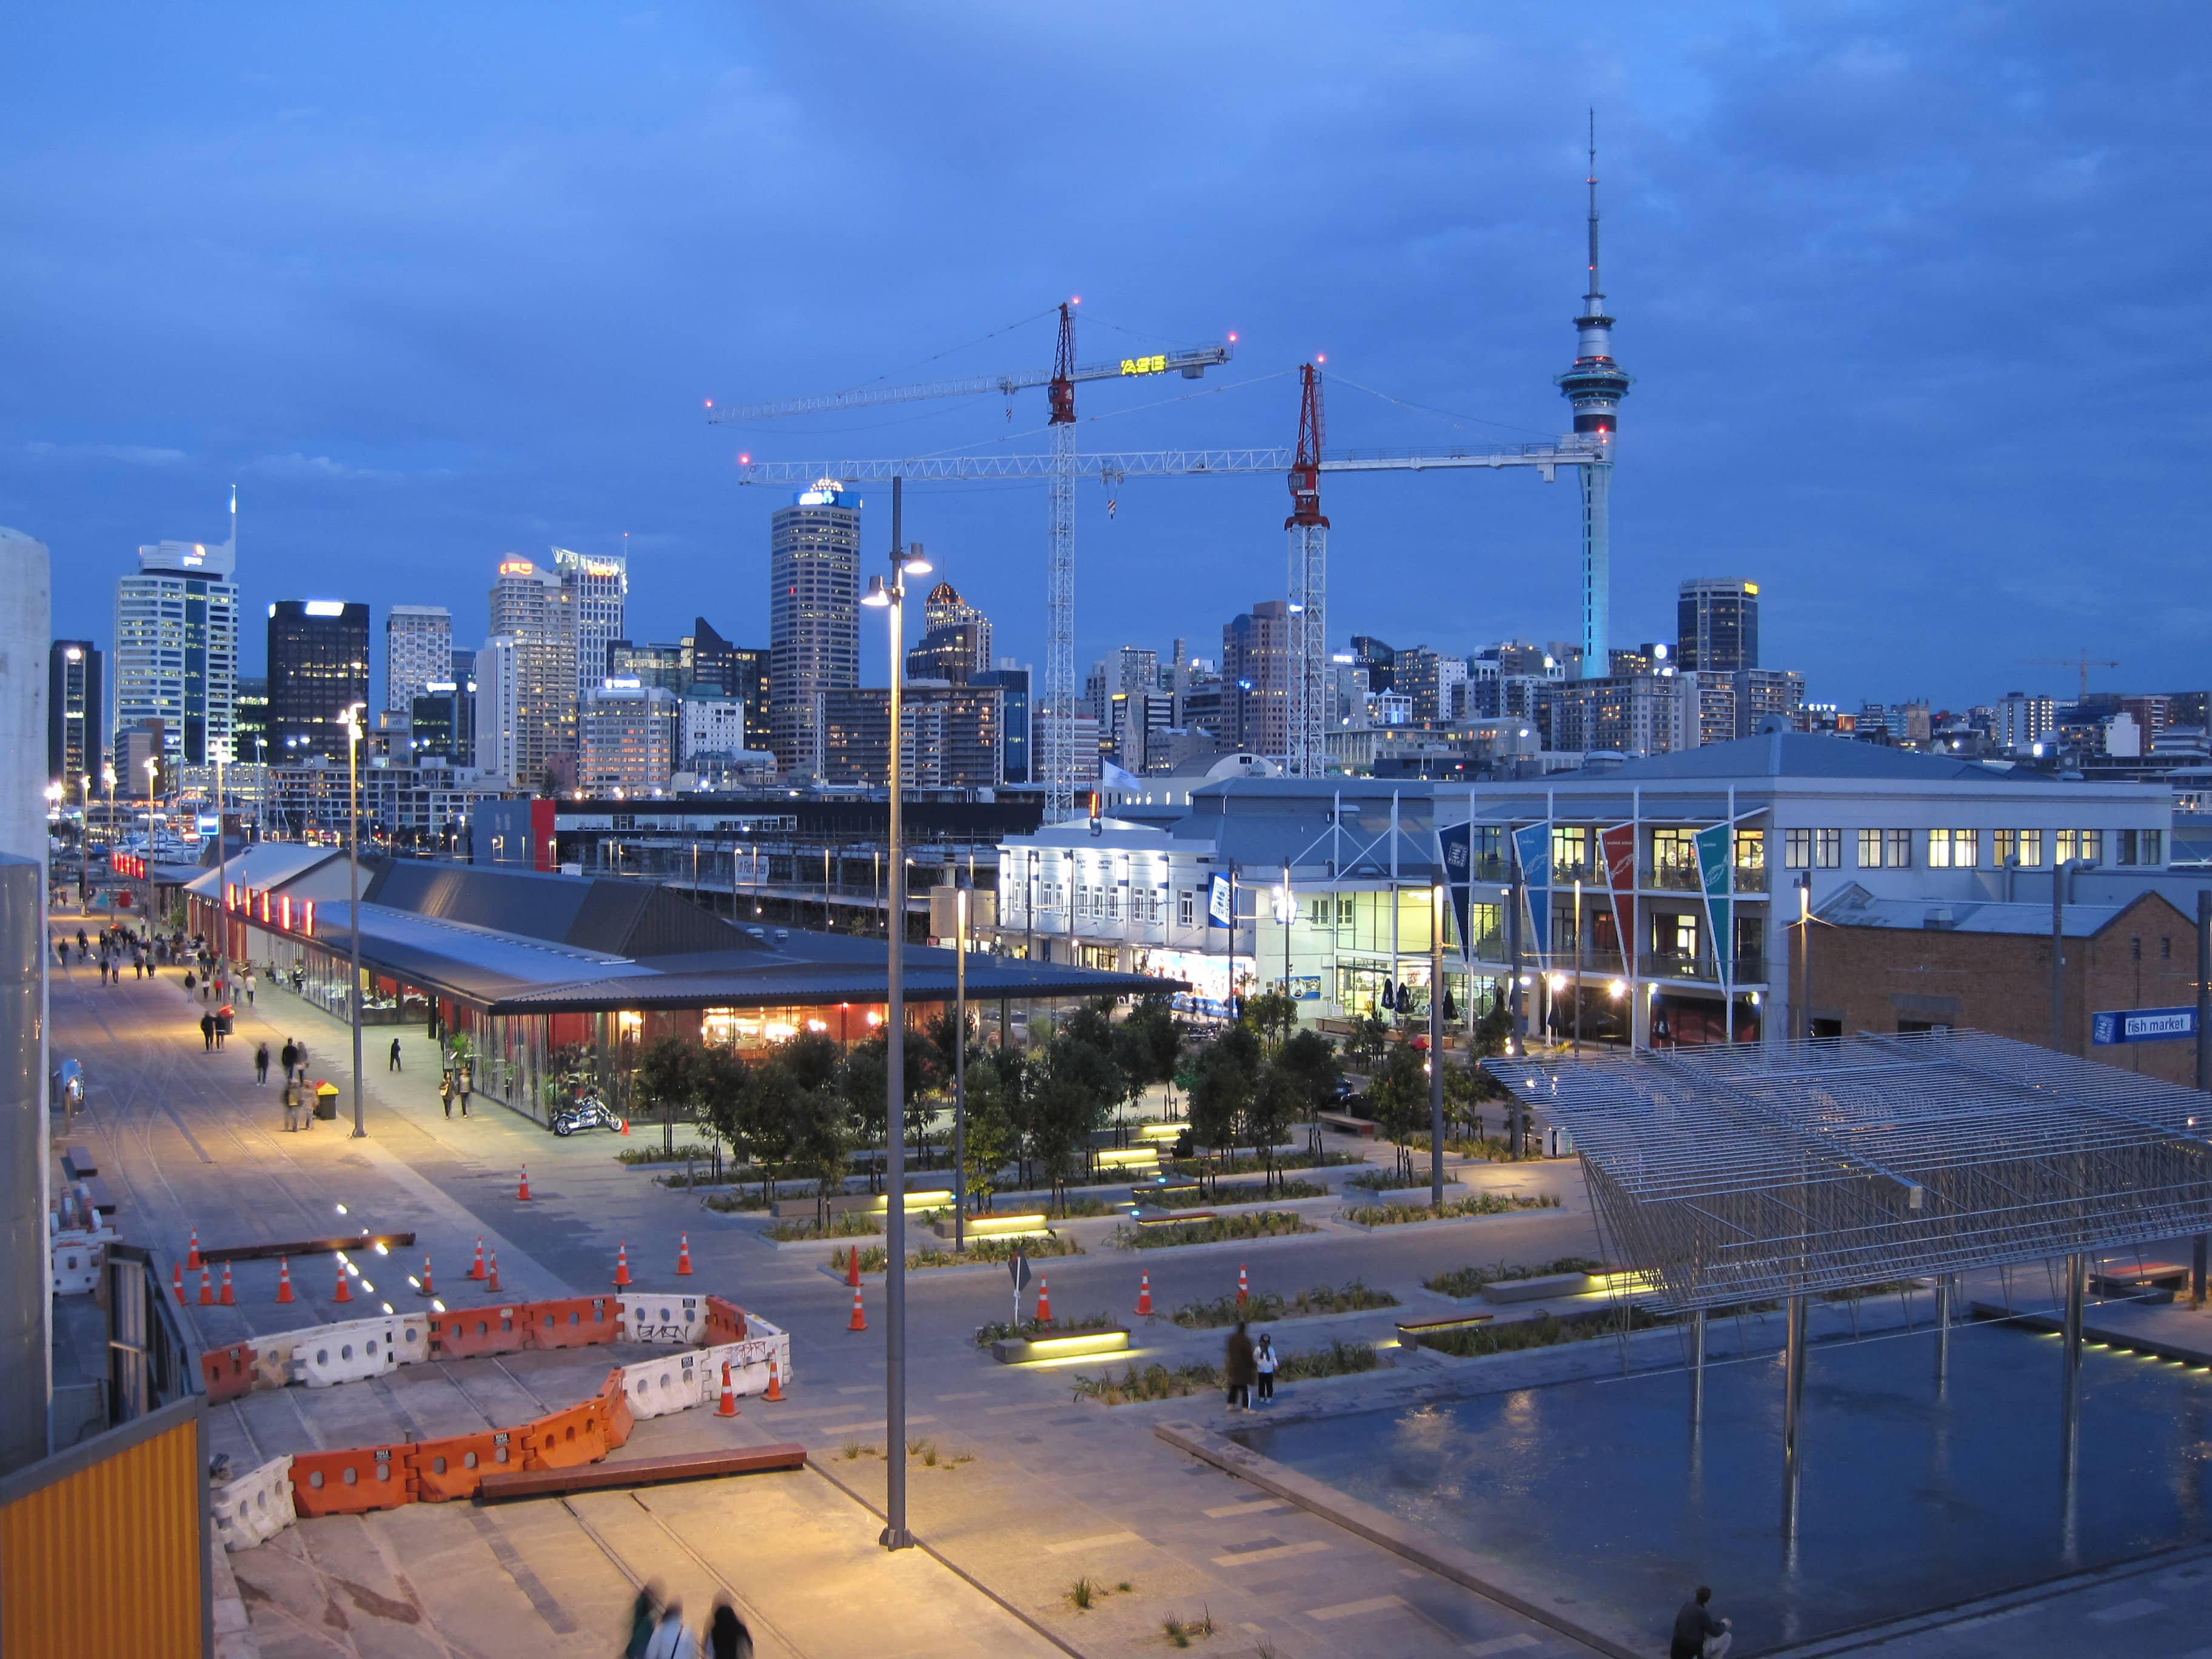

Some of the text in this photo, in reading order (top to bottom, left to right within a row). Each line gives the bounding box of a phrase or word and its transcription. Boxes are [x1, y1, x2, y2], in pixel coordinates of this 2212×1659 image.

[743, 861, 766, 874] Flether
[2128, 1019, 2146, 1033] fish
[2150, 1017, 2184, 1031] market
